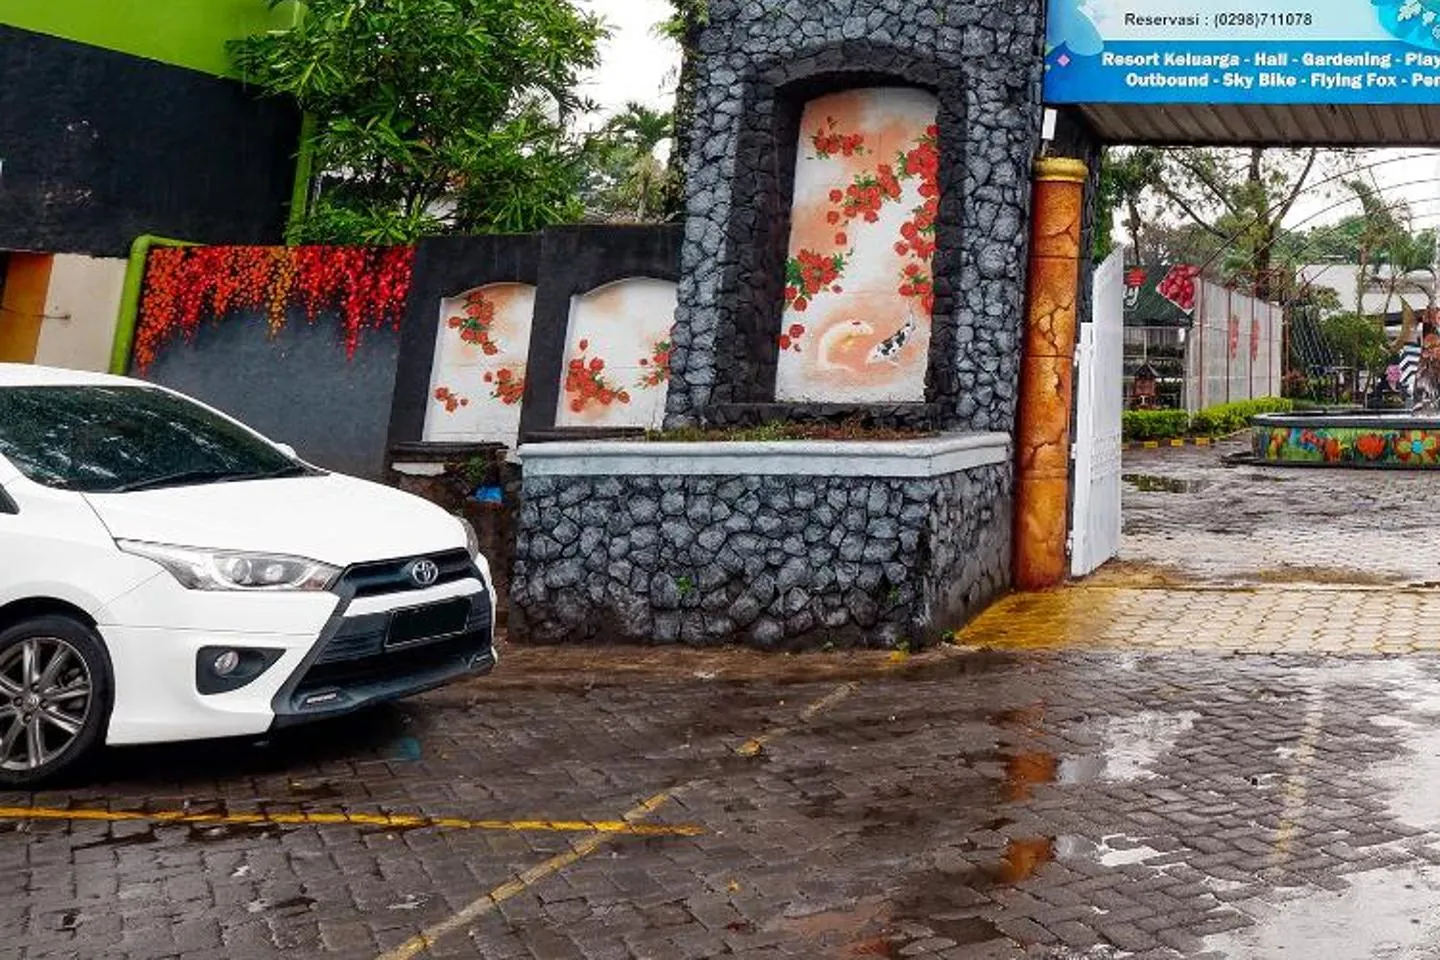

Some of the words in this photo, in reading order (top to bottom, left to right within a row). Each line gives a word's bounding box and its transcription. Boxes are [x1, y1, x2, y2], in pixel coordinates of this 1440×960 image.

[1124, 12, 1200, 26] Reservasi
[1214, 12, 1313, 30] (0298)711078
[1102, 52, 1160, 67] Resort
[1164, 52, 1240, 69] Keluarga
[1254, 52, 1288, 66] Hall
[1302, 52, 1392, 69] Gardening
[1126, 72, 1209, 87] Outbound
[1222, 72, 1254, 89] Sky
[1259, 72, 1297, 87] Bike
[1310, 72, 1362, 89] Flying
[1366, 72, 1397, 87] Fox
